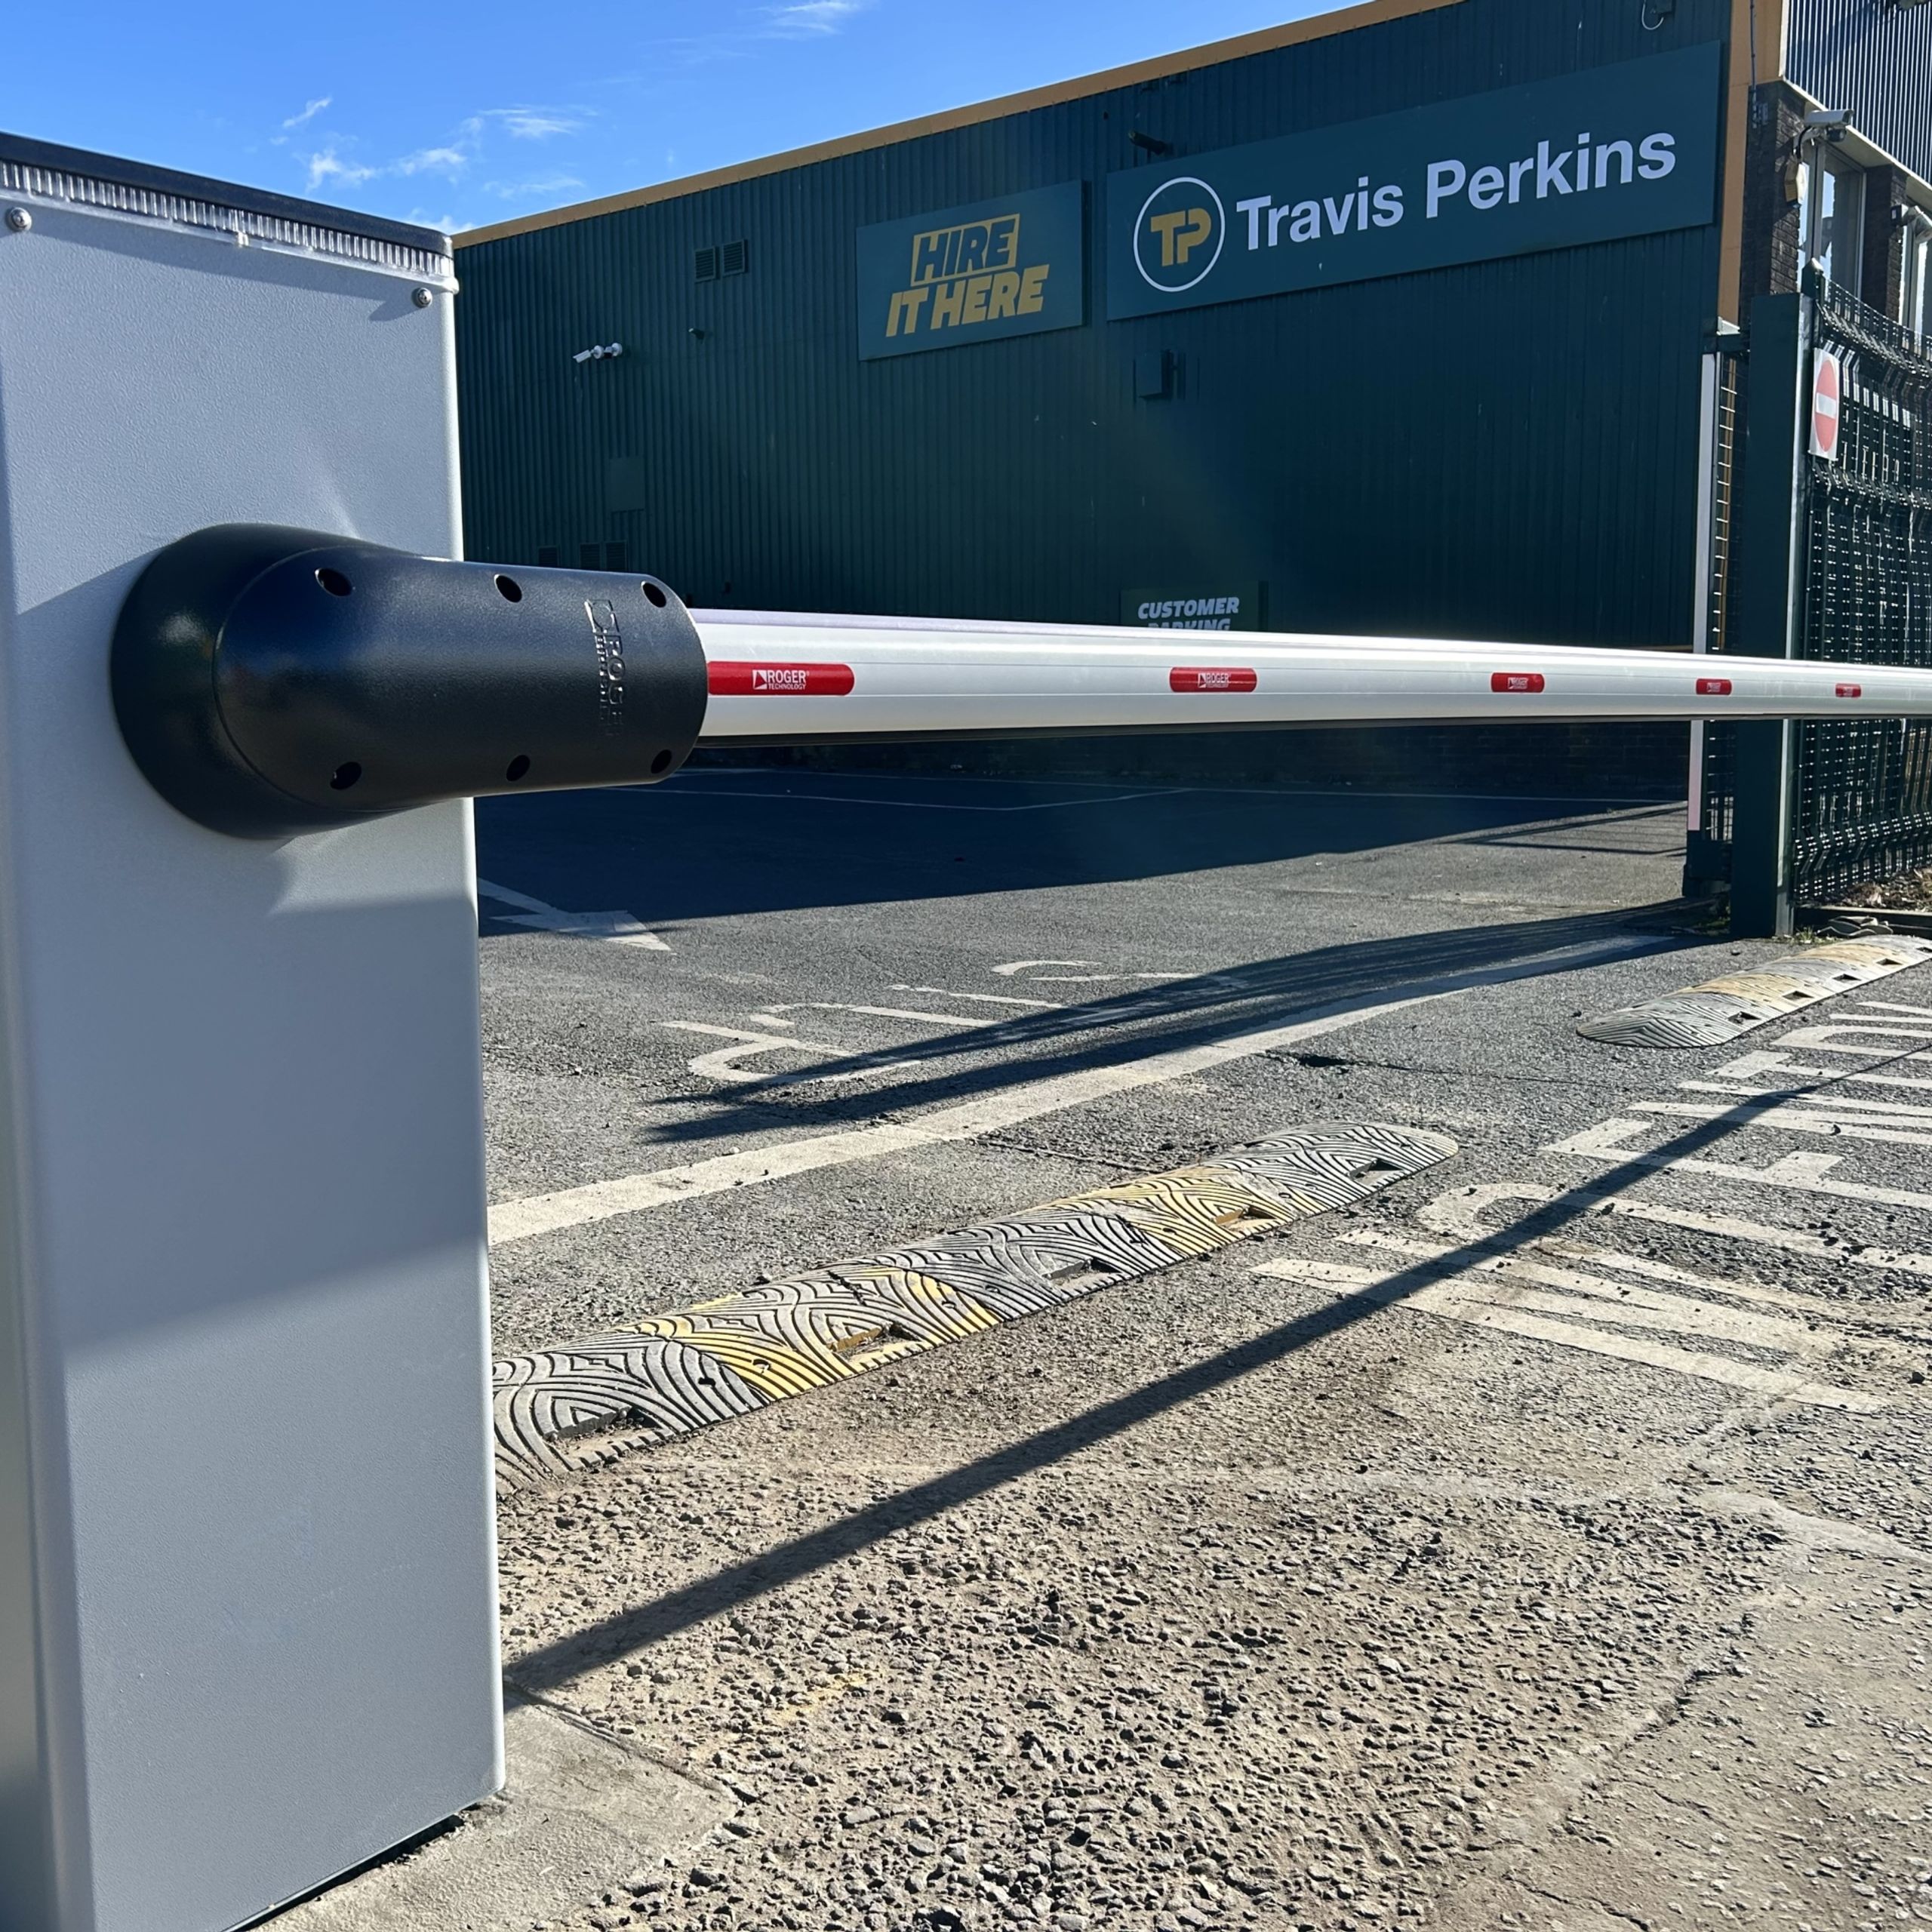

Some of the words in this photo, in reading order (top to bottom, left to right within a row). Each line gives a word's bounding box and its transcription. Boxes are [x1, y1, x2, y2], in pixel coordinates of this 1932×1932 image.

[1236, 176, 1404, 250] Travis
[1426, 132, 1676, 219] Perkins
[913, 217, 1017, 283] HIRE
[1151, 208, 1211, 266] TP
[885, 287, 929, 337] IT
[930, 264, 1050, 330] HERE
[1138, 596, 1239, 619] CUSTOMER
[768, 669, 807, 684] ROGER
